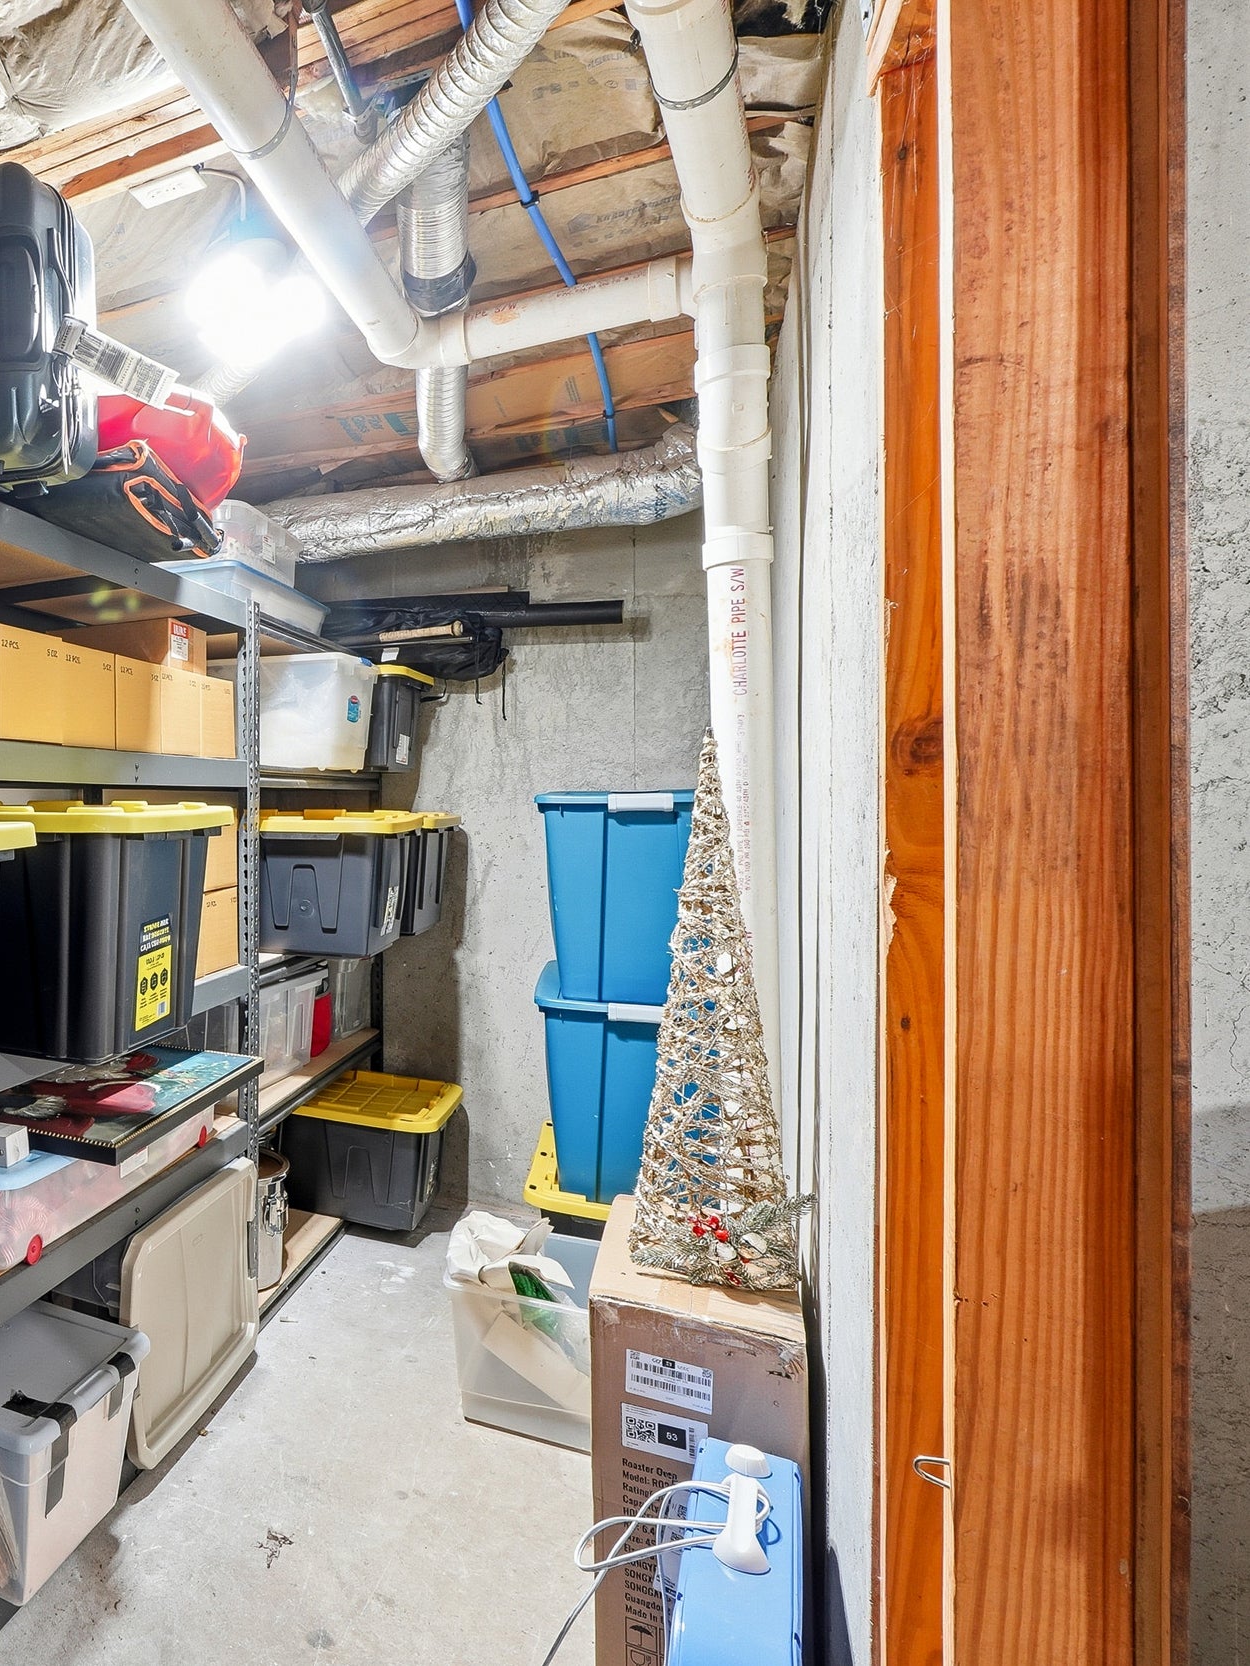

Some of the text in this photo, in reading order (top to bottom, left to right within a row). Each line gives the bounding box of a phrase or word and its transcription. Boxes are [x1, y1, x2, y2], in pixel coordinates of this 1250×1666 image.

[730, 567, 746, 592] S/W
[731, 598, 746, 624] PIPE
[731, 630, 748, 696] CHARLOTTE
[622, 1458, 678, 1480] Roaster Oven
[622, 1470, 650, 1485] Model:
[625, 1604, 648, 1619] Made
